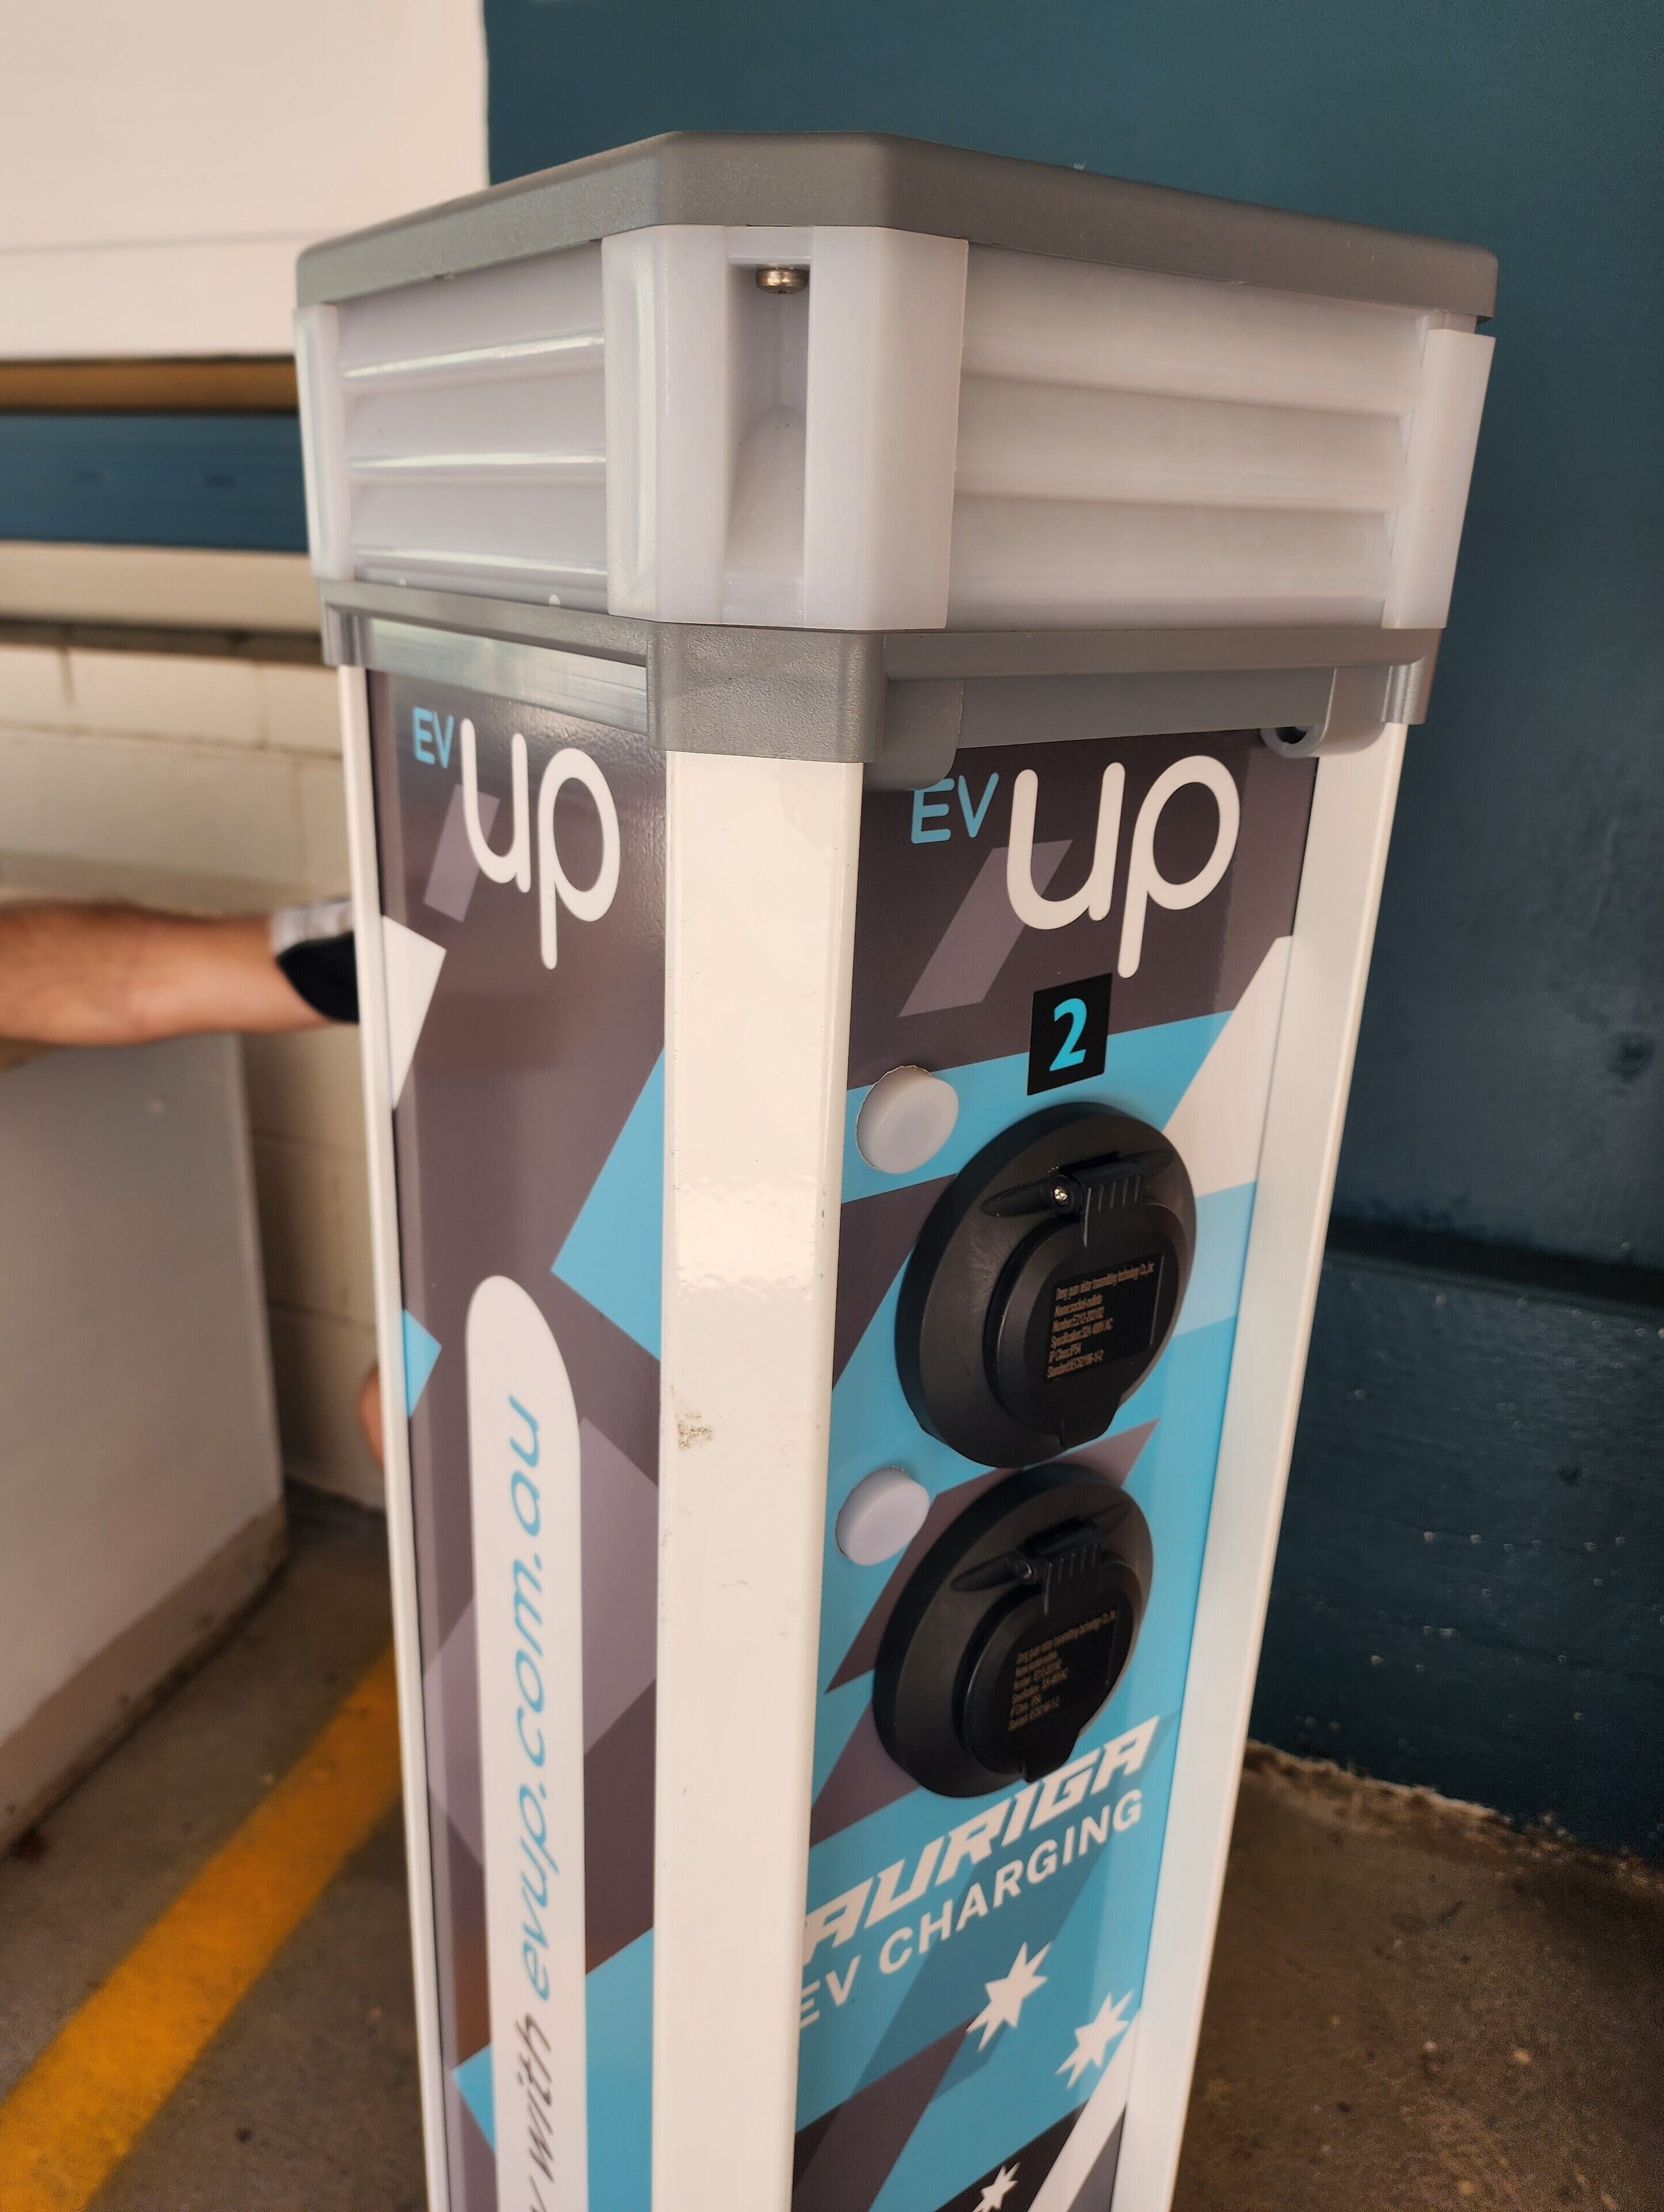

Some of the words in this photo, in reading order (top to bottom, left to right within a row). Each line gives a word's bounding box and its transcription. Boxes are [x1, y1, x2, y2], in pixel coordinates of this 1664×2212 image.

[413, 706, 454, 769] EV
[461, 718, 621, 970] up
[911, 772, 999, 844] EV
[1007, 755, 1240, 979] up
[1049, 997, 1088, 1072] 2
[507, 1394, 559, 2002] evup.com.au
[799, 1955, 862, 2029] EV
[878, 1789, 1142, 1975] CHARGING
[802, 1715, 1159, 1967] AURIGA
[516, 2012, 555, 2184] with
